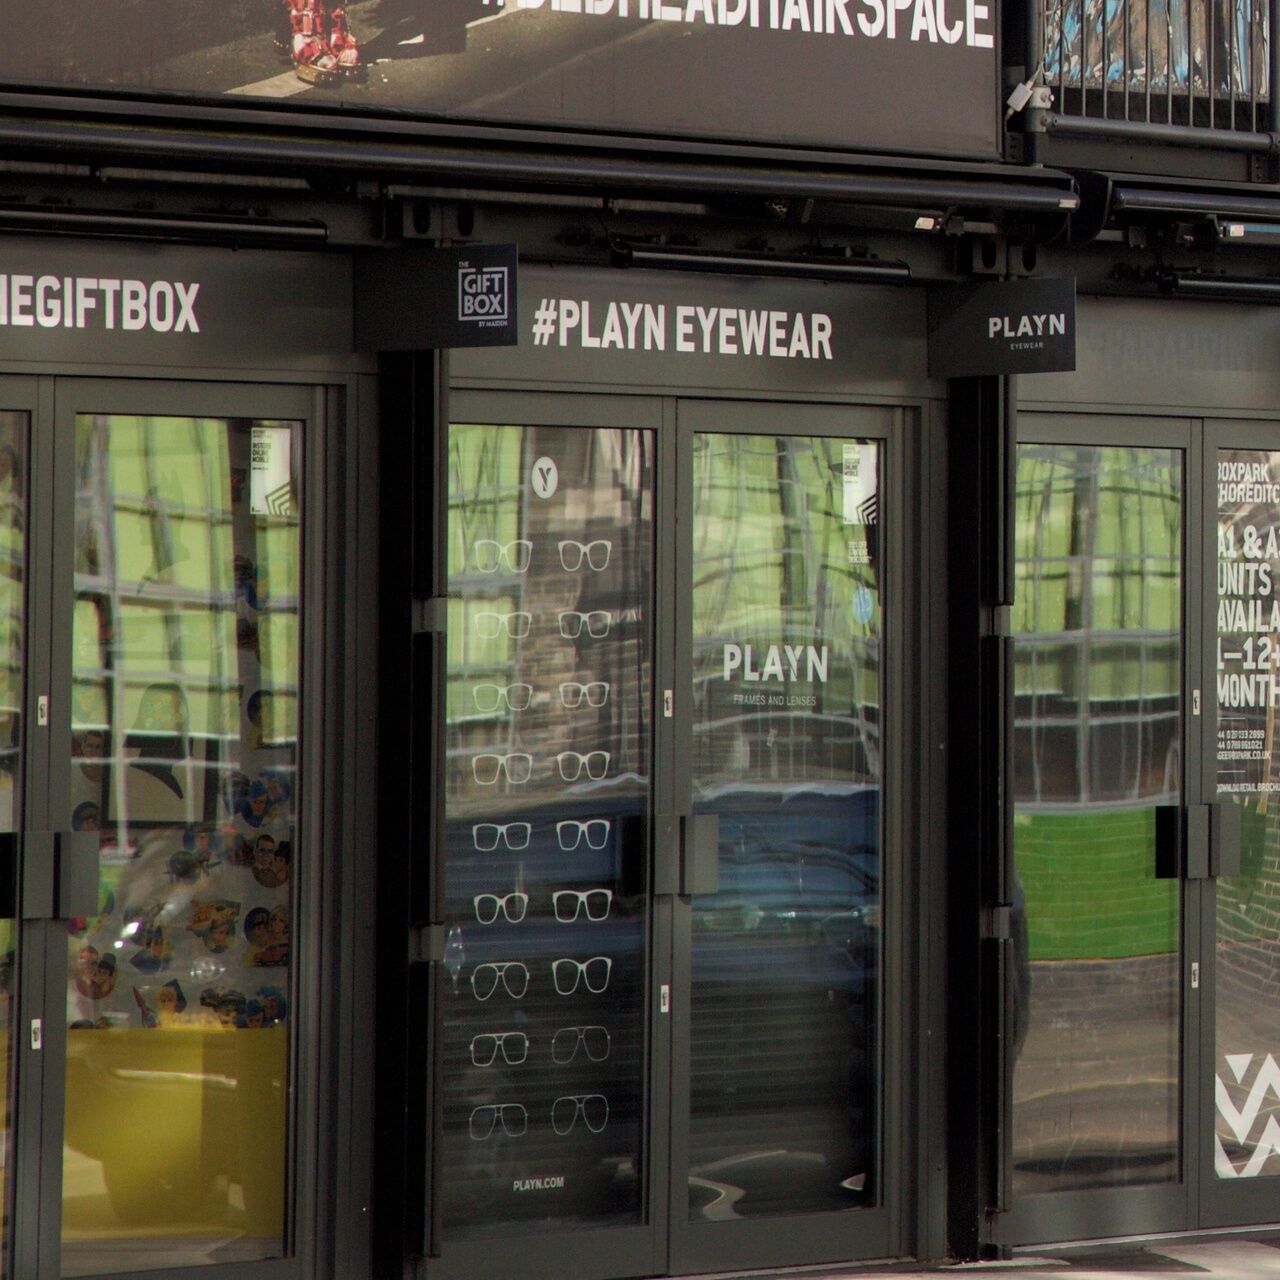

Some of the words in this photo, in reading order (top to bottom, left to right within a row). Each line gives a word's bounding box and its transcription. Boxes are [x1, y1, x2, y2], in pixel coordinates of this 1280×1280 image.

[463, 273, 503, 294] GIFT
[463, 294, 503, 314] BOX
[532, 298, 665, 351] #PLAYN
[676, 306, 833, 360] EYEWEAR
[988, 313, 1066, 338] PLAYN
[1010, 342, 1044, 350] EYEWEAR
[1243, 524, 1263, 559] &
[1217, 562, 1272, 596] UNITS
[723, 643, 828, 683] PLAYN
[733, 694, 766, 705] FRAMES
[767, 695, 784, 706] AND
[786, 696, 817, 706] LENSES
[513, 1176, 564, 1191] PLAYN.COM
